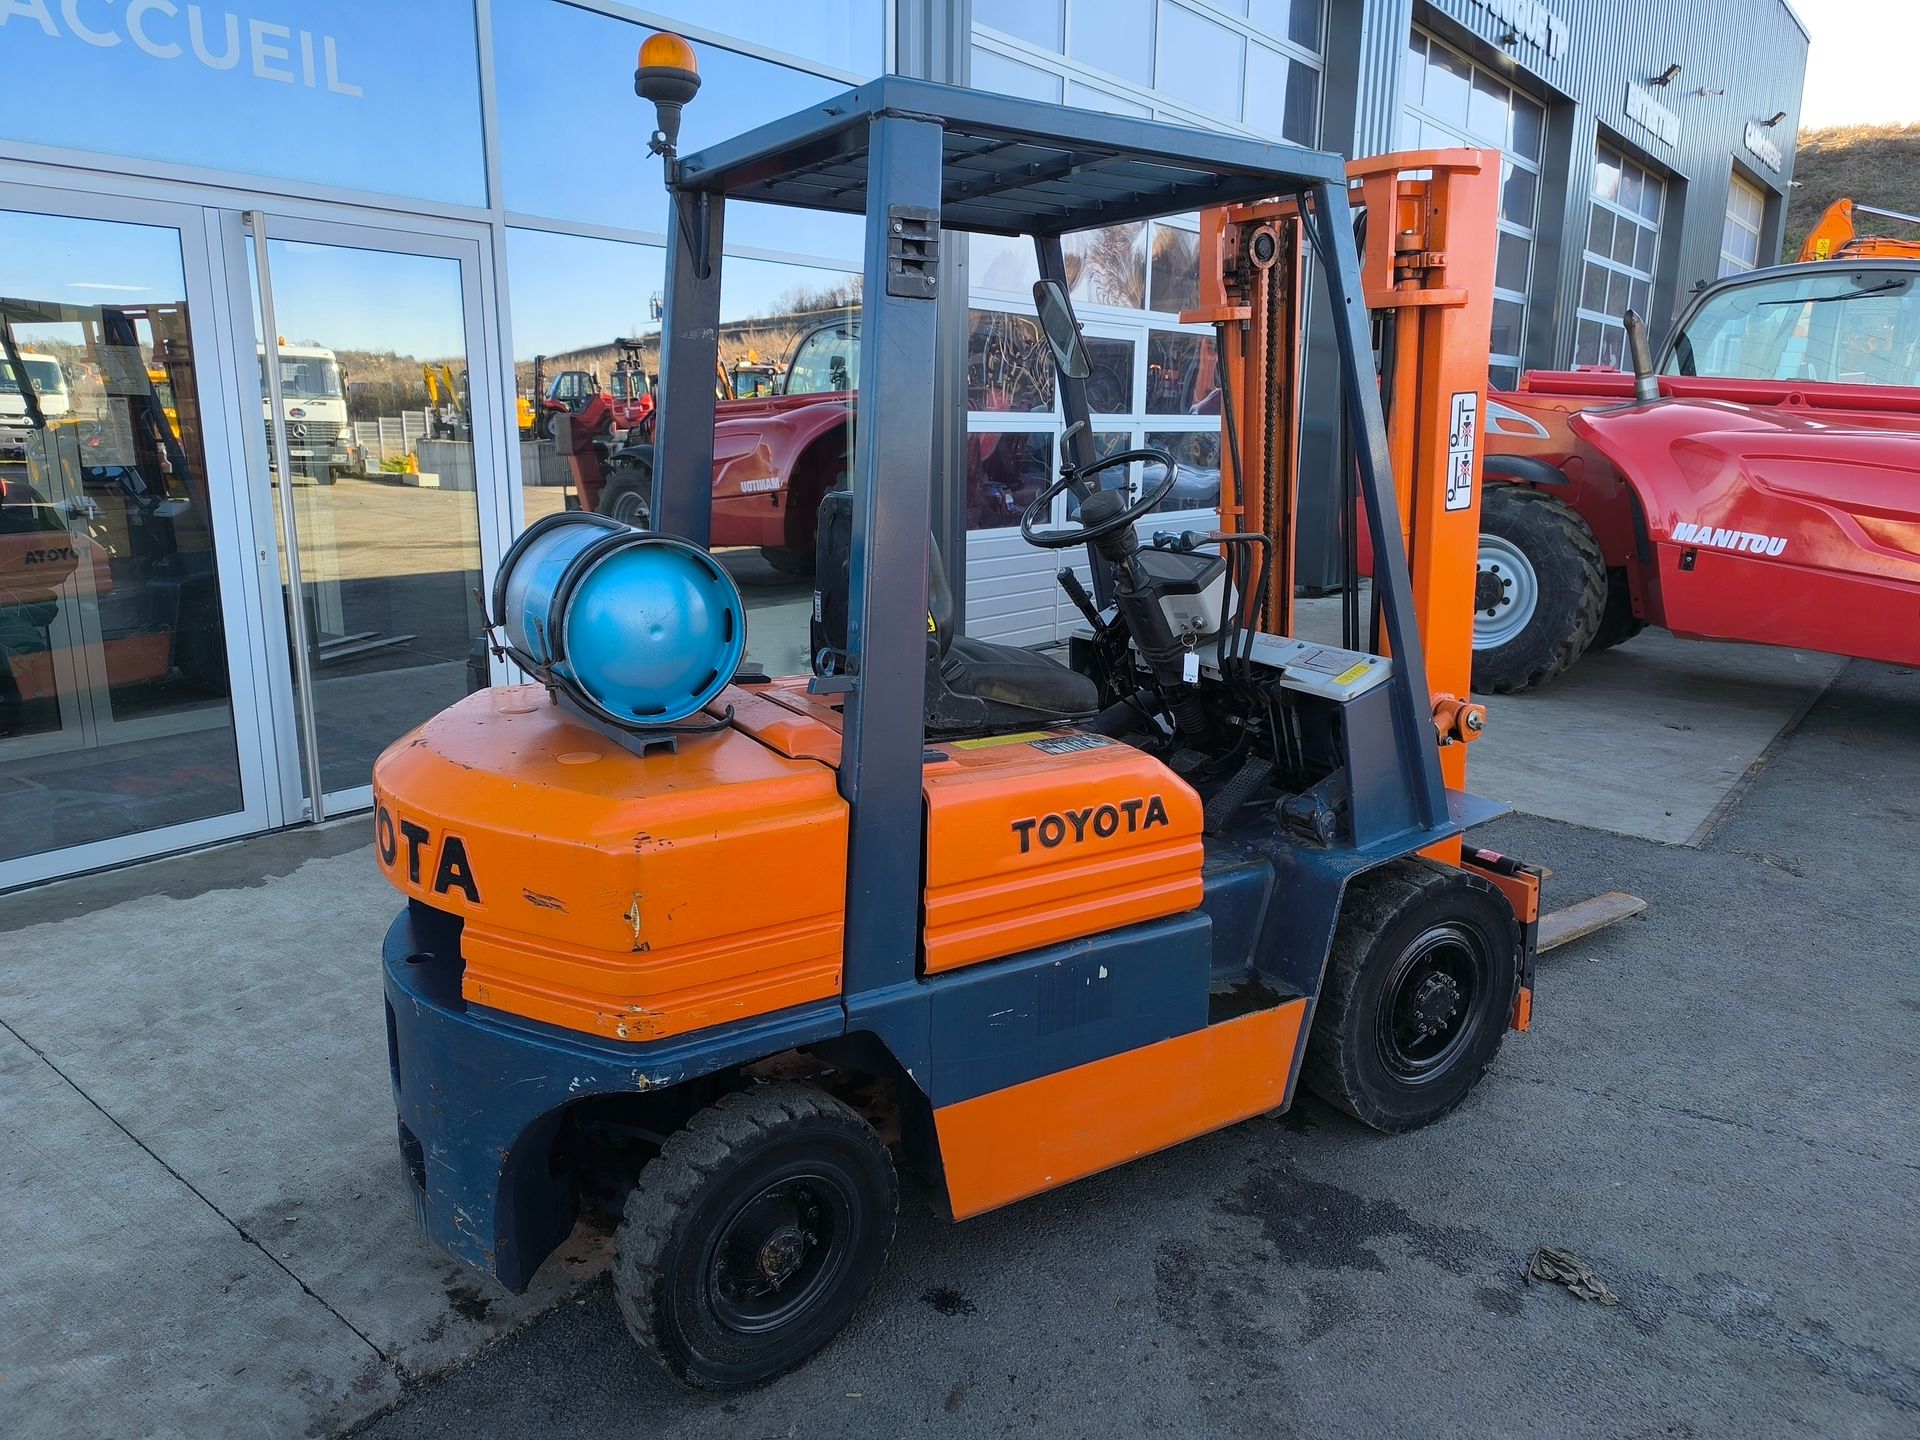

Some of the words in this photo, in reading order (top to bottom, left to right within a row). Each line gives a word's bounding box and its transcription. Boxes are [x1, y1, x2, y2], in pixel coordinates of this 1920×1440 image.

[1670, 521, 1788, 557] MANITOU
[374, 795, 482, 904] OTA
[1011, 796, 1169, 853] TOYOTA
